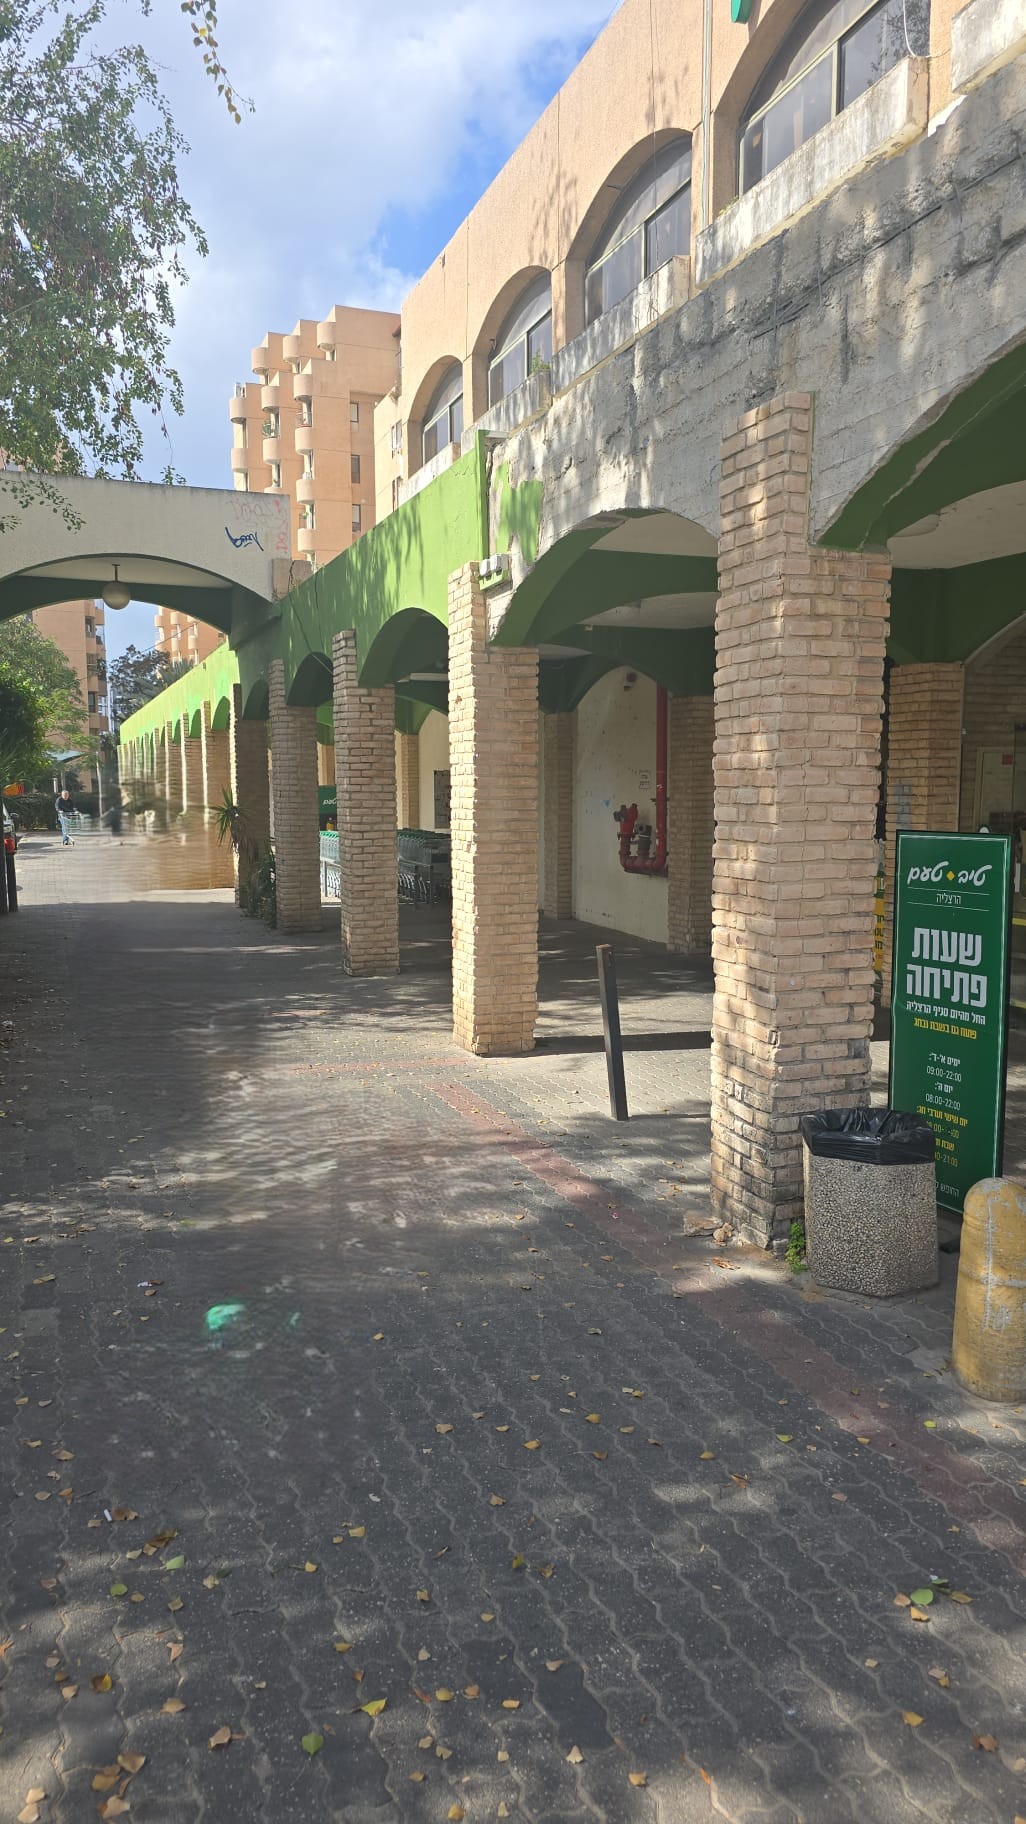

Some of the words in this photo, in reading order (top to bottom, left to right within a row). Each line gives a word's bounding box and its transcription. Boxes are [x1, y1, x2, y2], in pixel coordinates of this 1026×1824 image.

[907, 861, 950, 885] טעם
[957, 864, 993, 887] טיב
[936, 892, 961, 905] הרצליה
[911, 927, 982, 967] שעות
[906, 964, 988, 1008] פתיחה
[906, 1000, 931, 1014] הרצליה
[933, 1006, 949, 1017] סניף
[950, 1009, 970, 1021] מהיום
[971, 1012, 986, 1025] החל
[914, 1017, 929, 1029] ובחג
[930, 1021, 949, 1033] בשבת
[951, 1025, 960, 1035] גם
[960, 1027, 977, 1039] פתוח
[947, 1056, 961, 1067] ימים
[926, 1065, 962, 1082] 09:00-22:00
[944, 1084, 953, 1093] יום
[959, 1117, 968, 1127] יום
[941, 1139, 955, 1151] שבת
